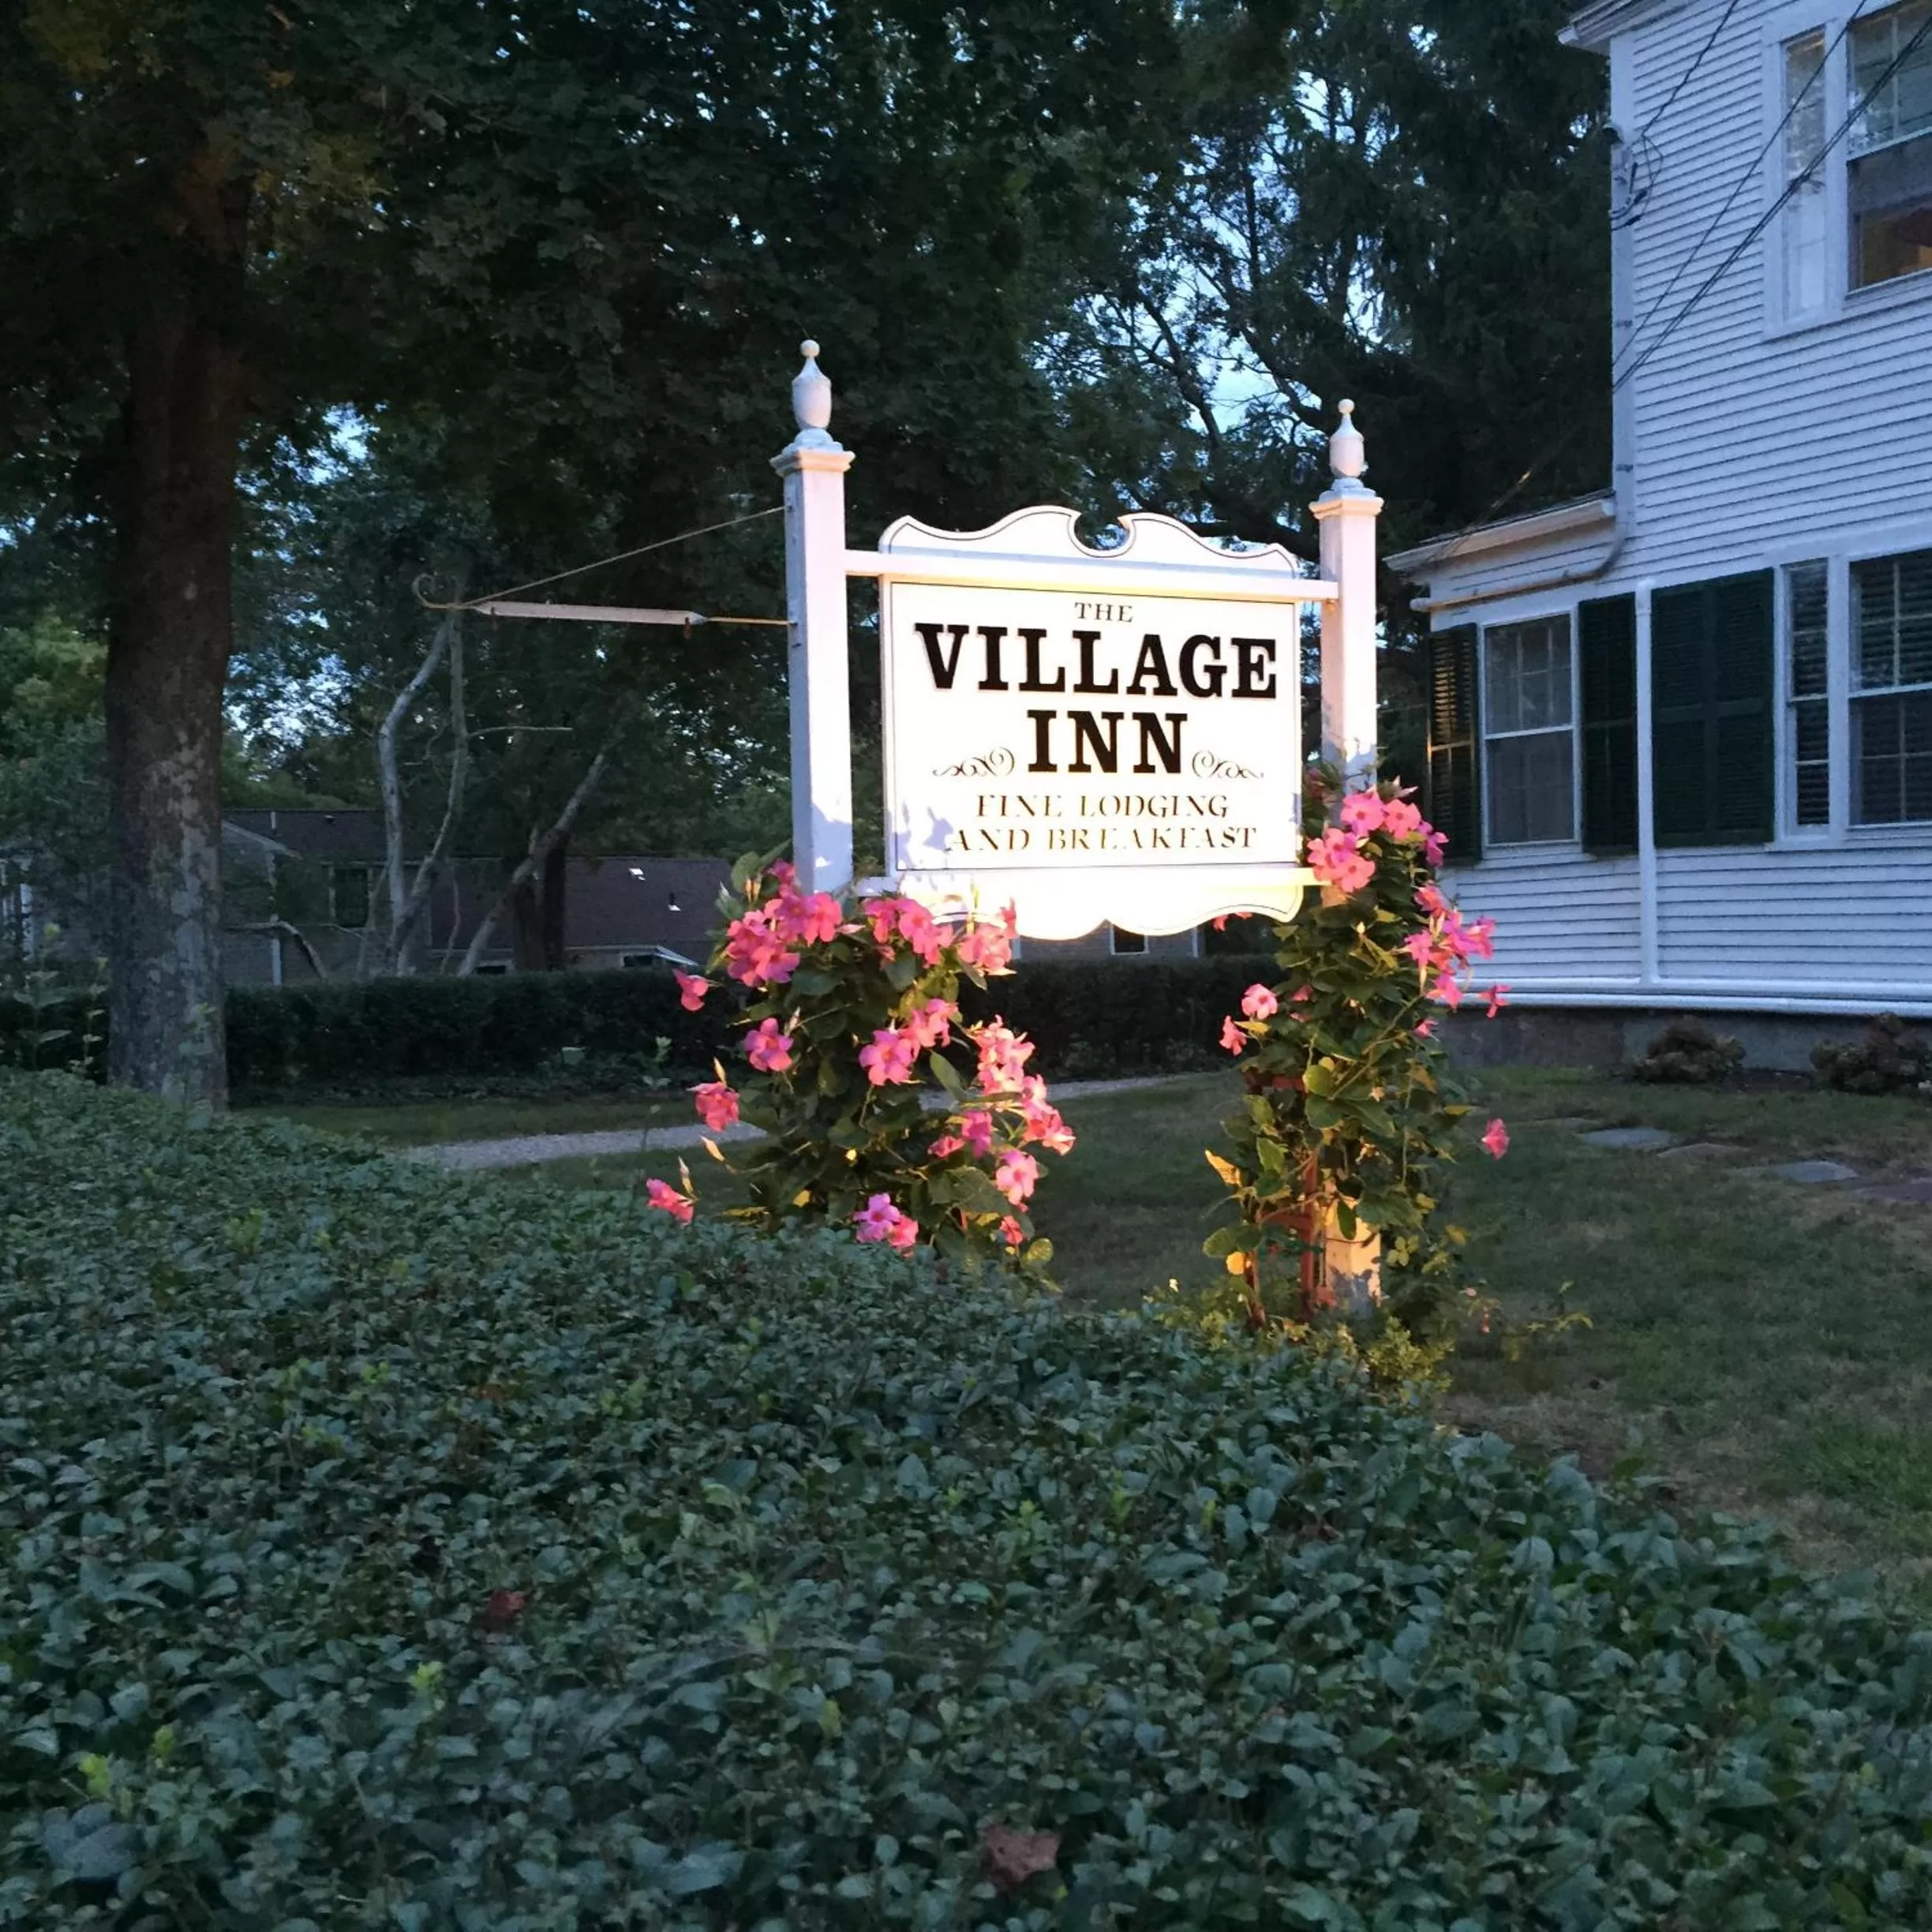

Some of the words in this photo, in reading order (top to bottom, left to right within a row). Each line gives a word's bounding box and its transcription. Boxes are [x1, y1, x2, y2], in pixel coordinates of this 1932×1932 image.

[1074, 601, 1134, 623] THE
[914, 622, 1277, 700] VILLAGE
[1027, 709, 1189, 774] INN
[976, 794, 1062, 818] FINE
[1080, 794, 1230, 818] LODGING
[946, 828, 1030, 852] AND
[1047, 826, 1257, 851] BREAKFAST
